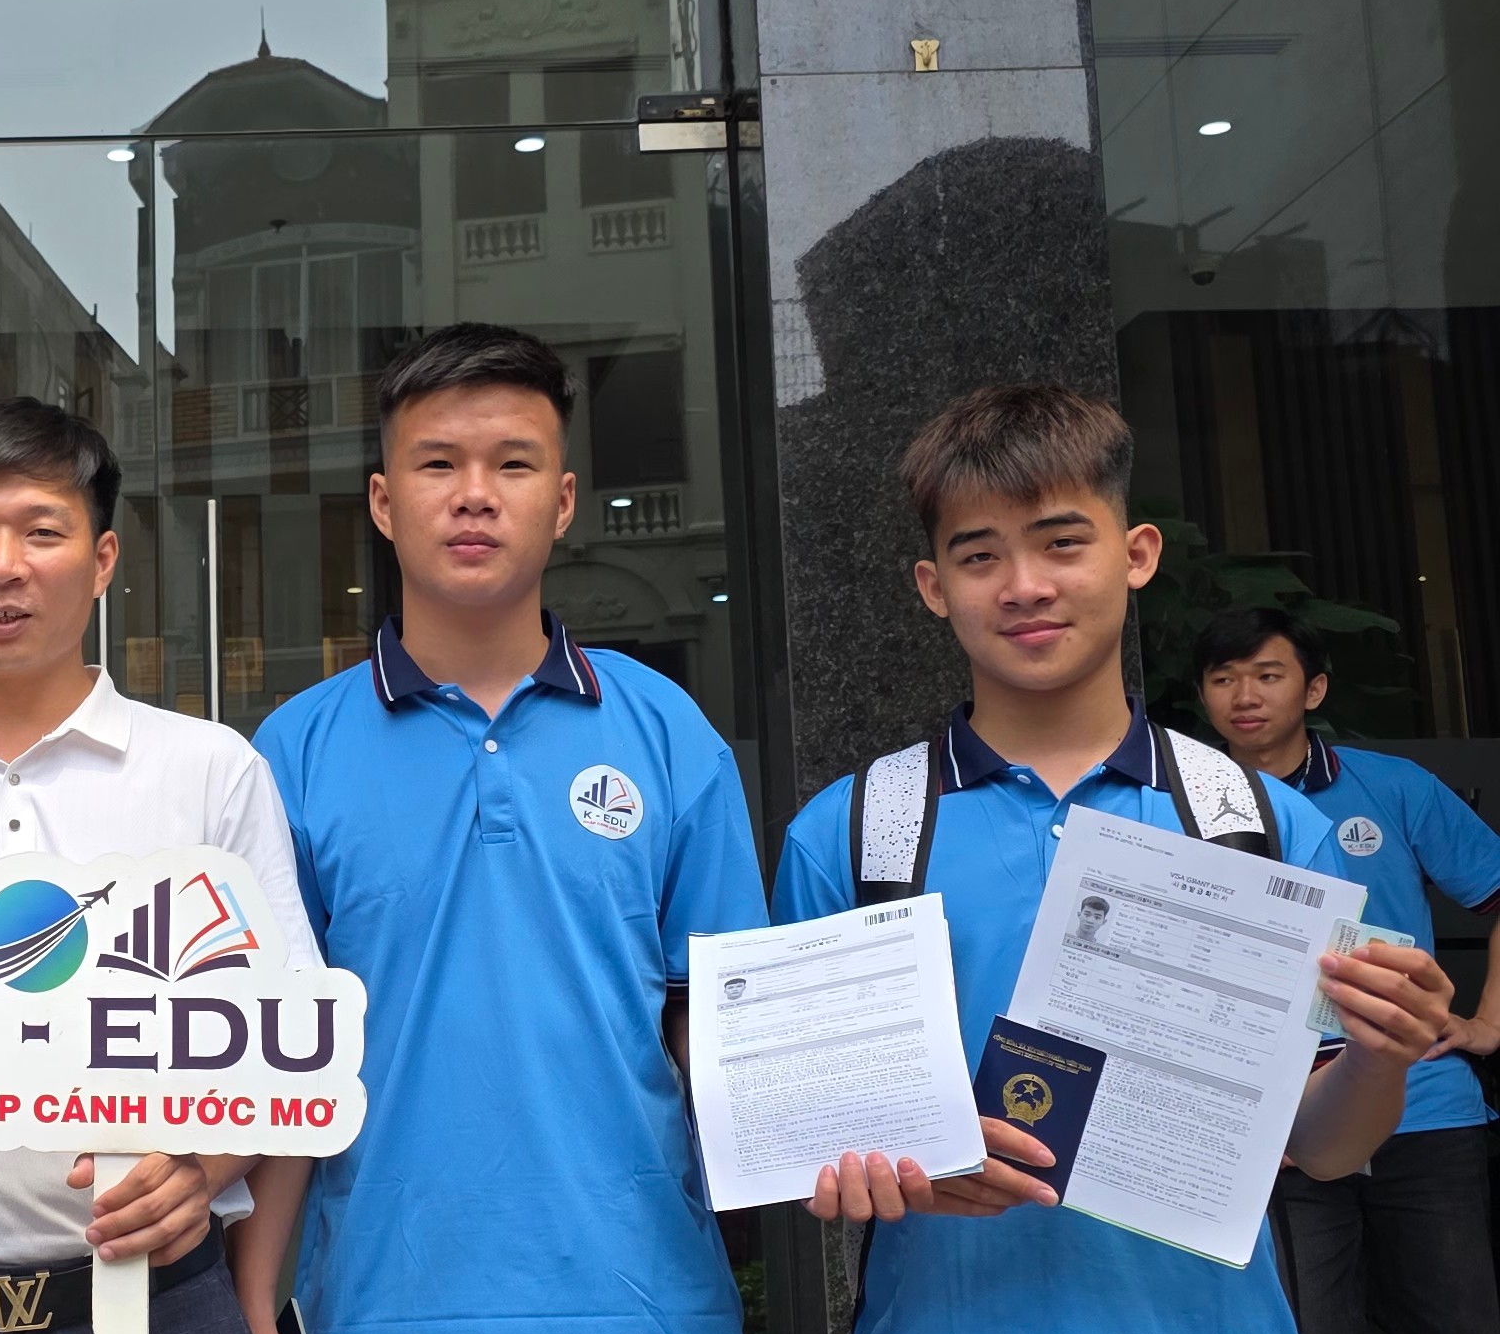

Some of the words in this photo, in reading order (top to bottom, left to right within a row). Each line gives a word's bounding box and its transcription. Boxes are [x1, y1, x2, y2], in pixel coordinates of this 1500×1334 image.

[603, 813, 627, 828] EDU
[1170, 871, 1186, 882] VISA
[86, 993, 338, 1073] EDU
[33, 1087, 147, 1124] CÁNH
[163, 1088, 256, 1127] ƯỚC
[270, 1097, 337, 1127] MƠ
